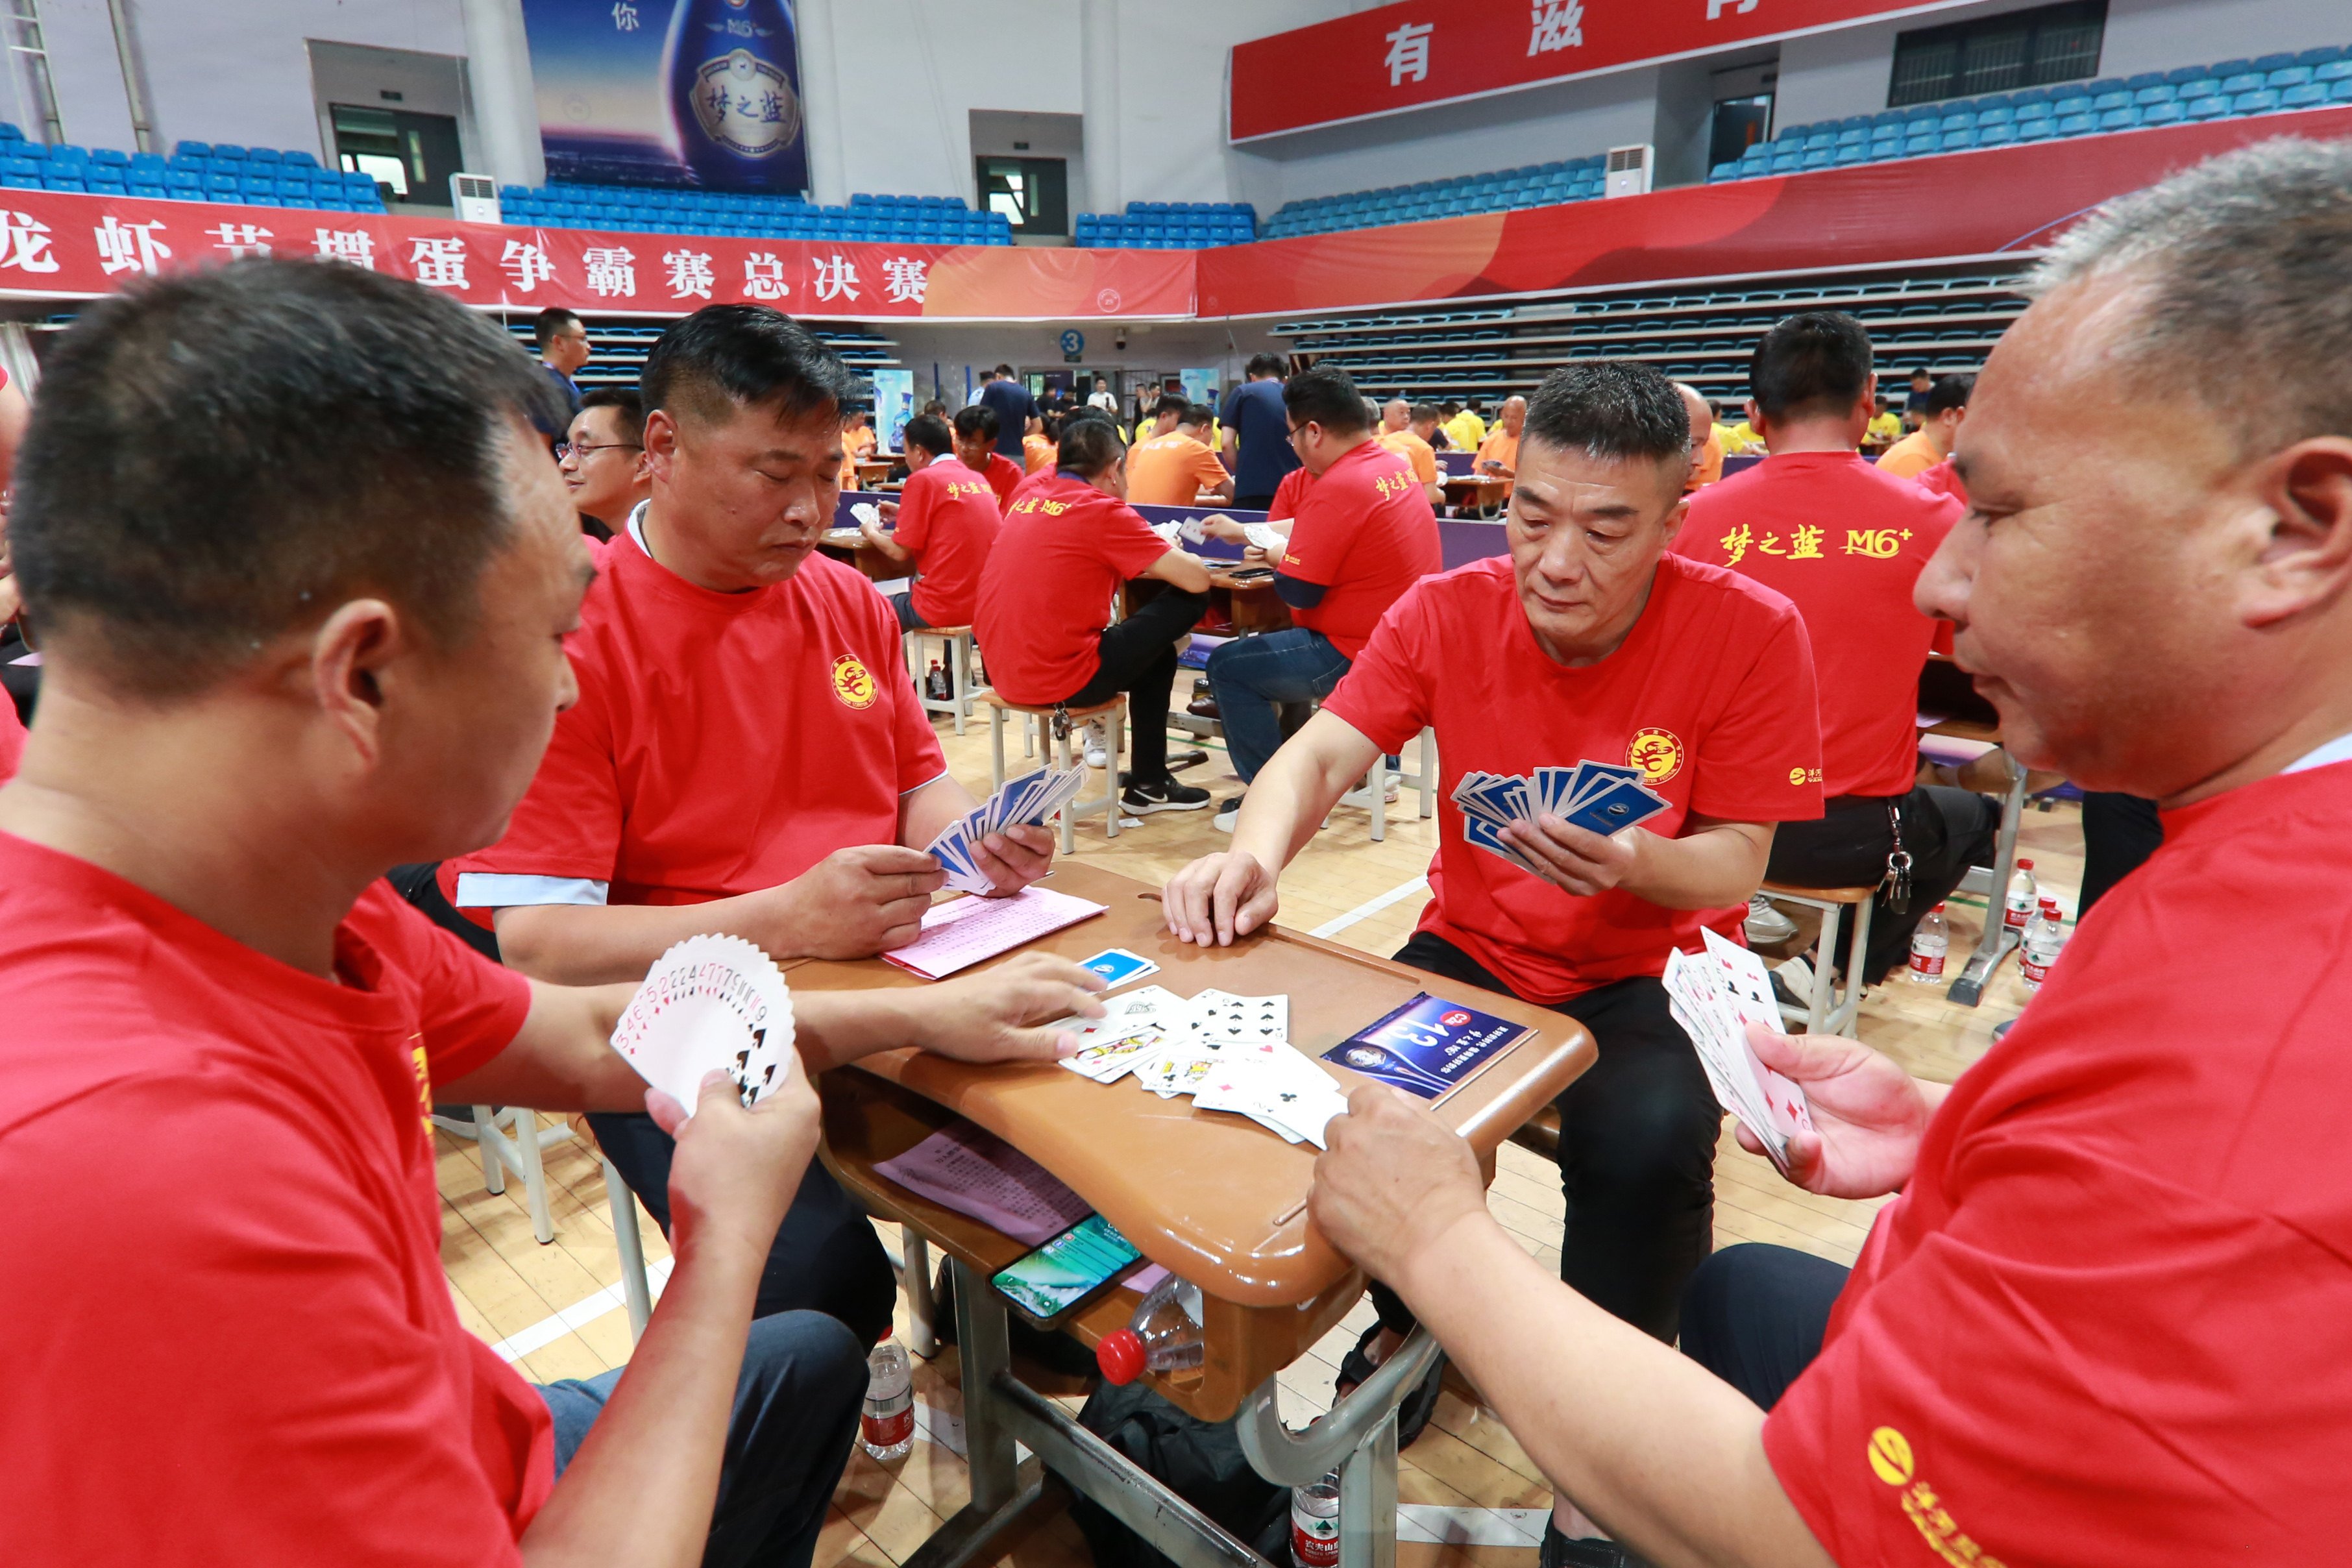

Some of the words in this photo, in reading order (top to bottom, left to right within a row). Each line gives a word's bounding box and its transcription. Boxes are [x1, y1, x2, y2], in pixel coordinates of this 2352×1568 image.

[612, 2, 640, 31] 你
[1065, 332, 1079, 352] 3
[1039, 499, 1072, 517] M6+
[1720, 523, 1825, 567] 梦之蓝
[1838, 528, 1913, 559] M6+
[659, 976, 668, 995] 2
[1391, 1016, 1451, 1047] 13
